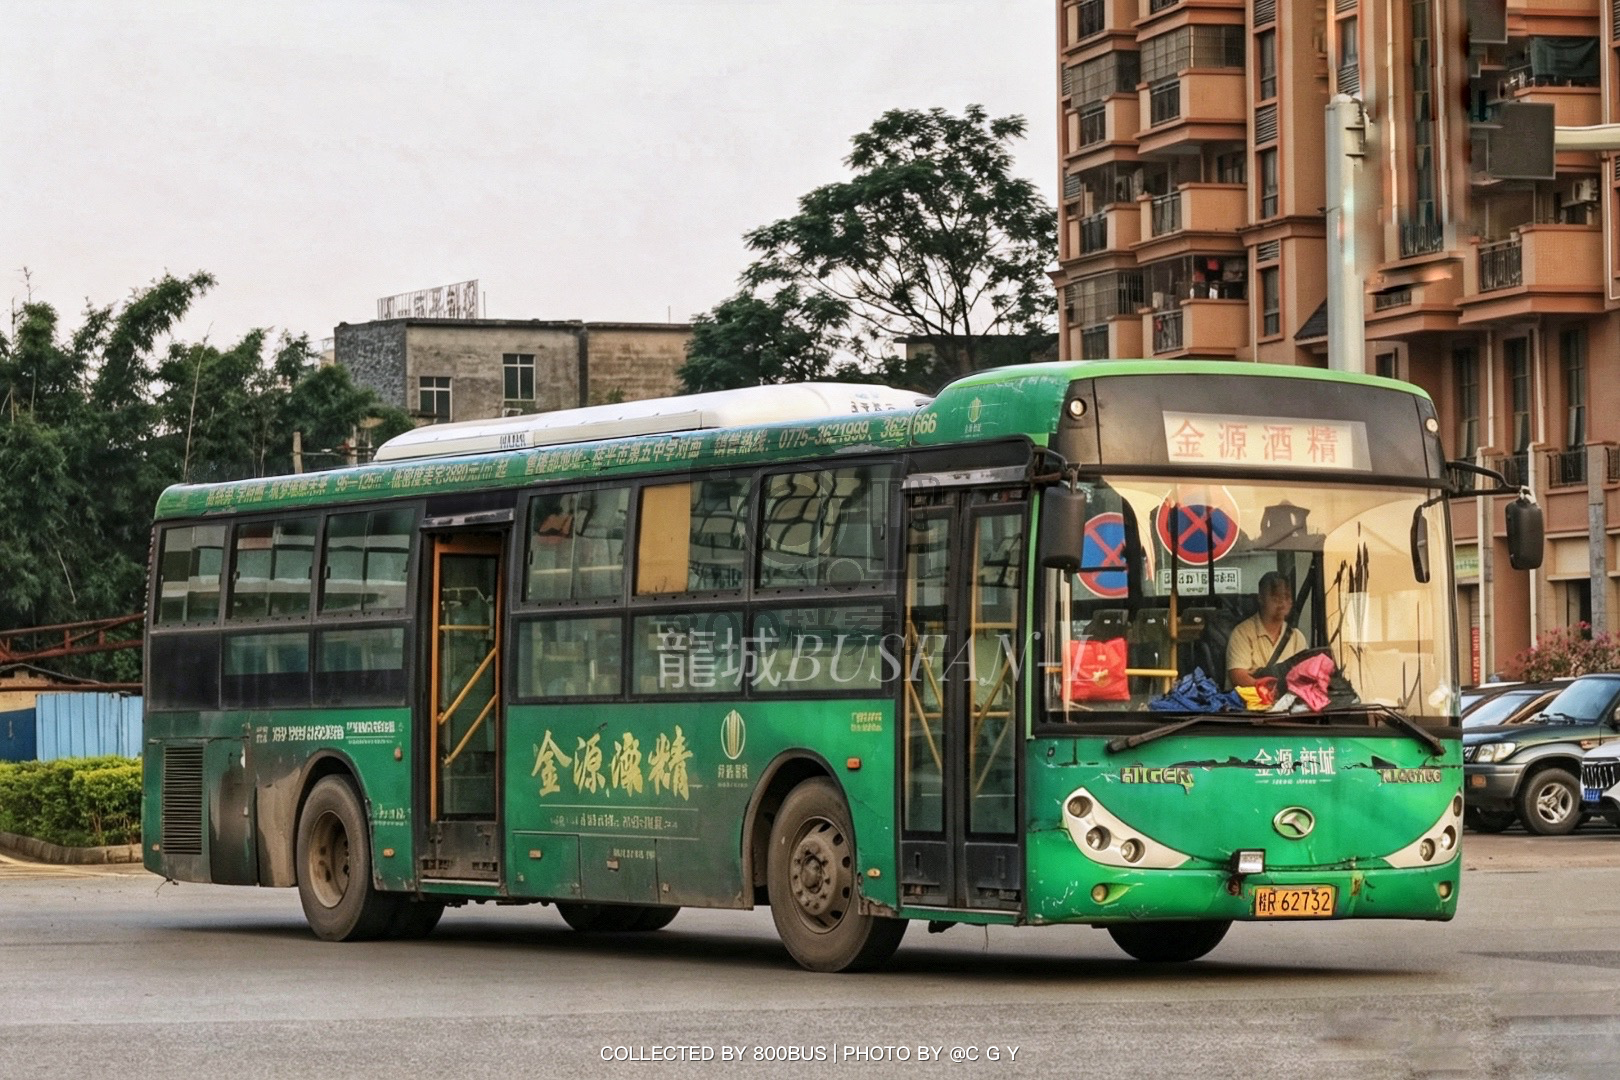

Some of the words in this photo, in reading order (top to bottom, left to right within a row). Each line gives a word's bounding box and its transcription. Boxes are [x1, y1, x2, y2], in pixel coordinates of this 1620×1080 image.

[1171, 419, 1339, 464] 金源酒精
[1120, 767, 1193, 784] HIGER
